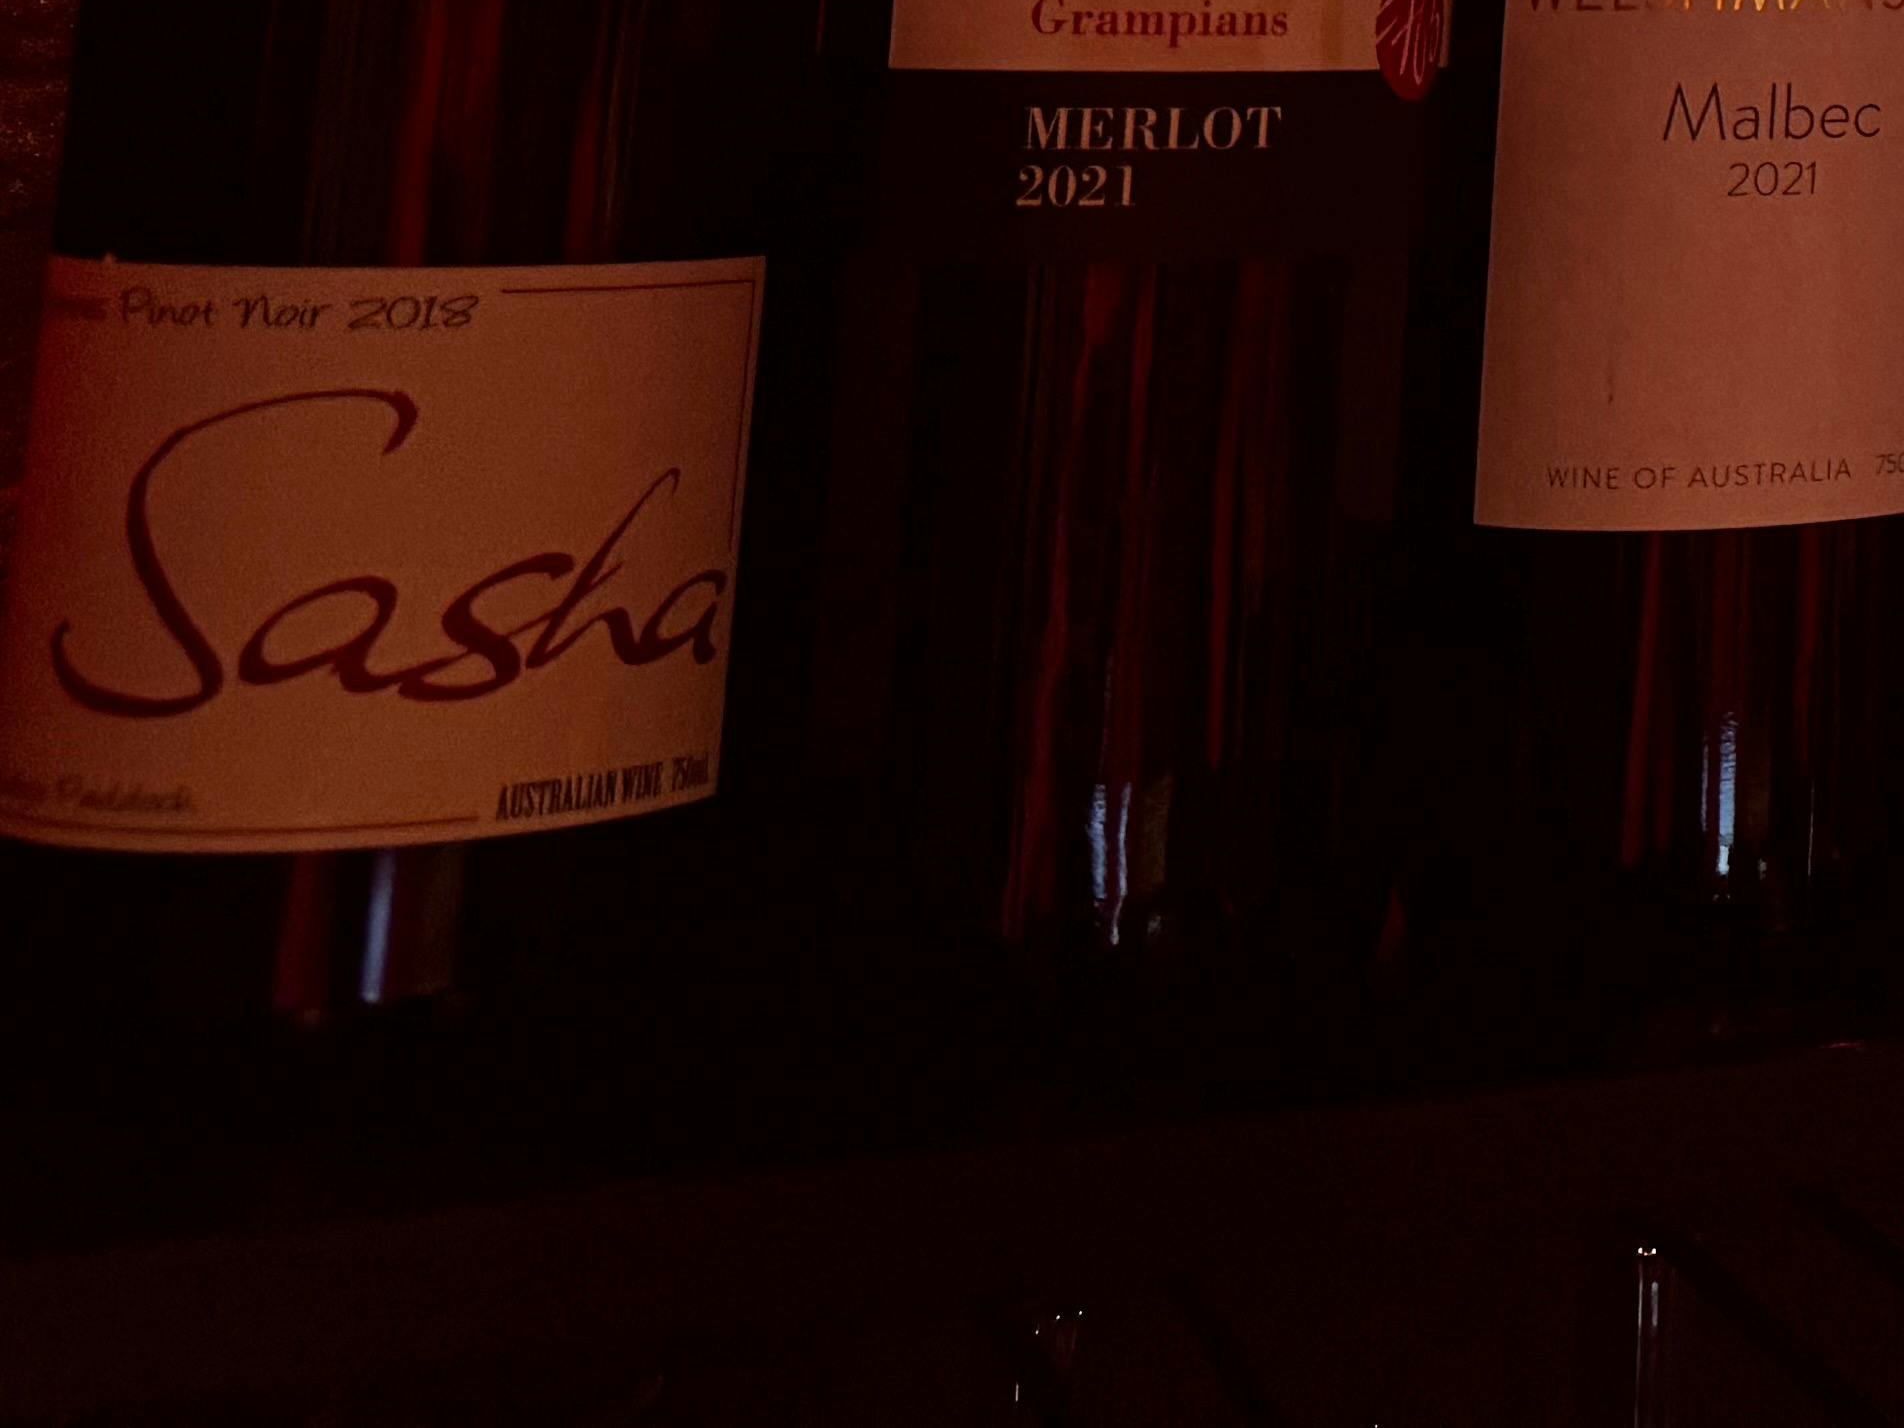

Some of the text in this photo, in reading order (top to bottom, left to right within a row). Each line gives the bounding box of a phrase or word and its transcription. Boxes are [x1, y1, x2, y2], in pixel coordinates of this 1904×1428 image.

[1020, 105, 1283, 152] MERLOT
[1662, 81, 1882, 142] Malbec
[1014, 163, 1136, 208] 2021
[1726, 162, 1818, 198] 2021
[120, 284, 215, 328] Pinot
[233, 292, 333, 330] Noir
[347, 293, 481, 331] 2018
[1546, 465, 1621, 491] WINE
[1633, 465, 1675, 490] OF
[1687, 458, 1853, 489] AUSTRALIA
[50, 388, 727, 718] Sasha
[495, 769, 617, 822] AUSTRALIAN
[621, 761, 664, 804] WINE
